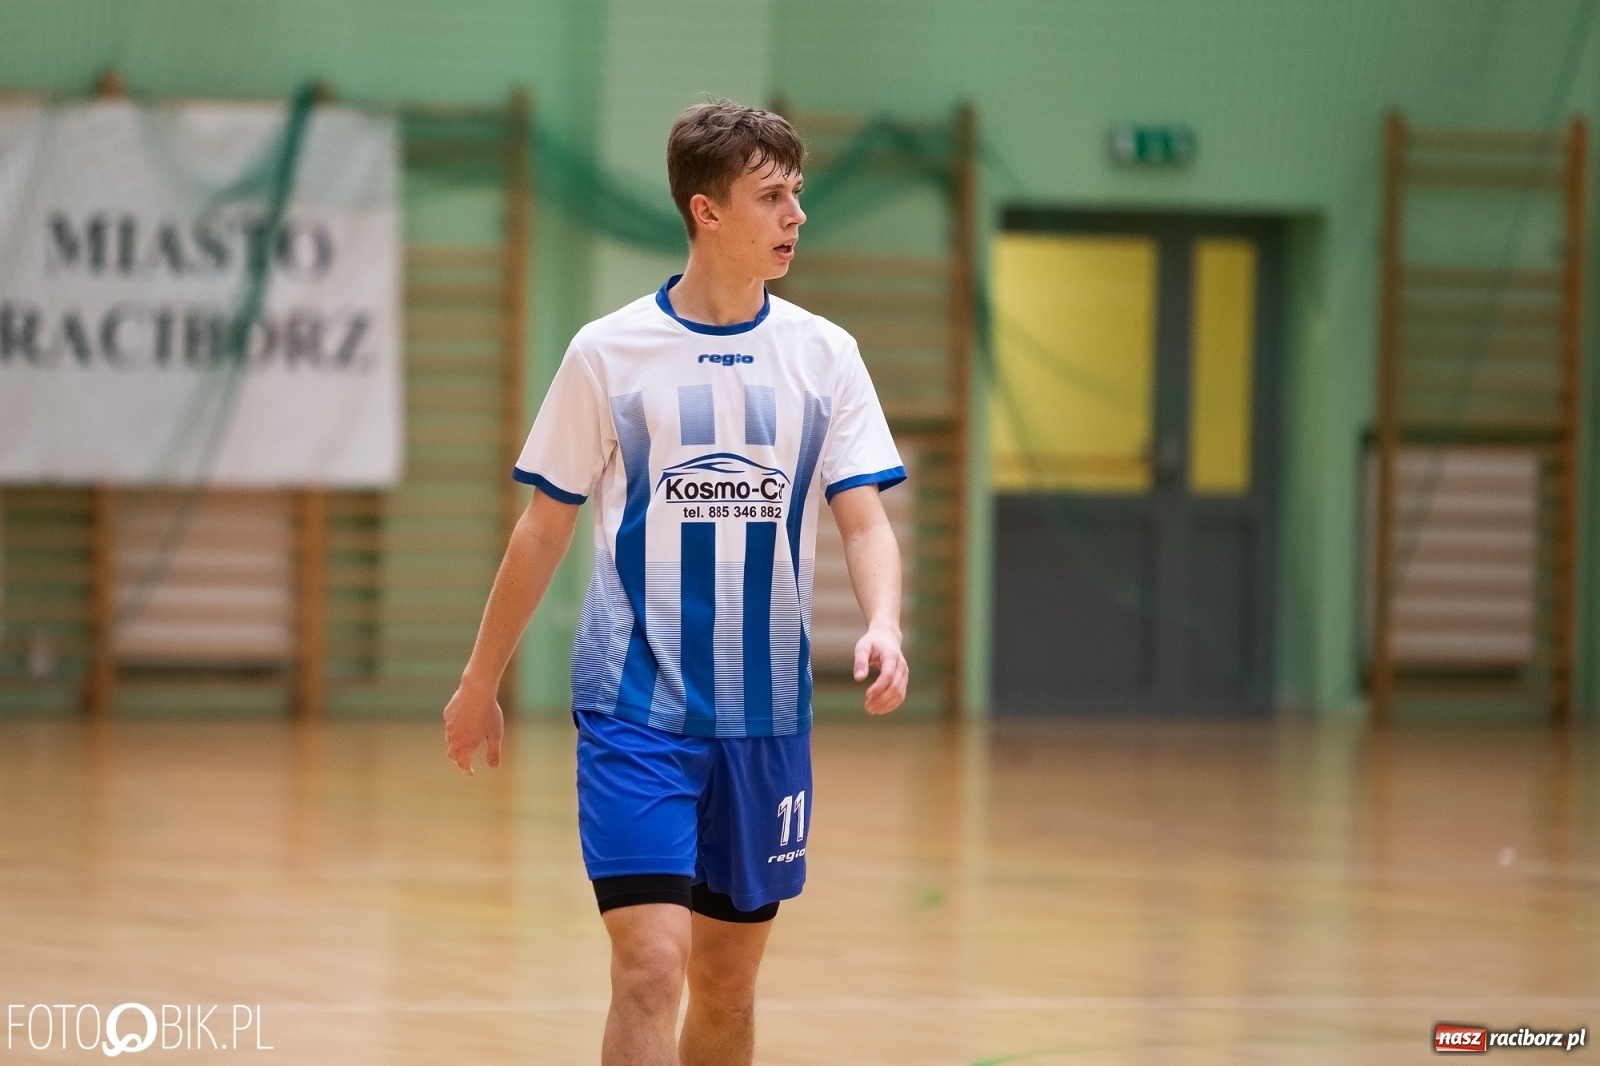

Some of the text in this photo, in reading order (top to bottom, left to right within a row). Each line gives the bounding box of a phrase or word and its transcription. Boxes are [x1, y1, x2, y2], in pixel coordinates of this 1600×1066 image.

[45, 211, 335, 280] MIASTO
[697, 353, 754, 366] regio
[666, 478, 785, 500] Kosmo-C
[683, 506, 782, 518] tel. 885 346 882
[777, 790, 805, 847] 11
[767, 848, 806, 863] regio
